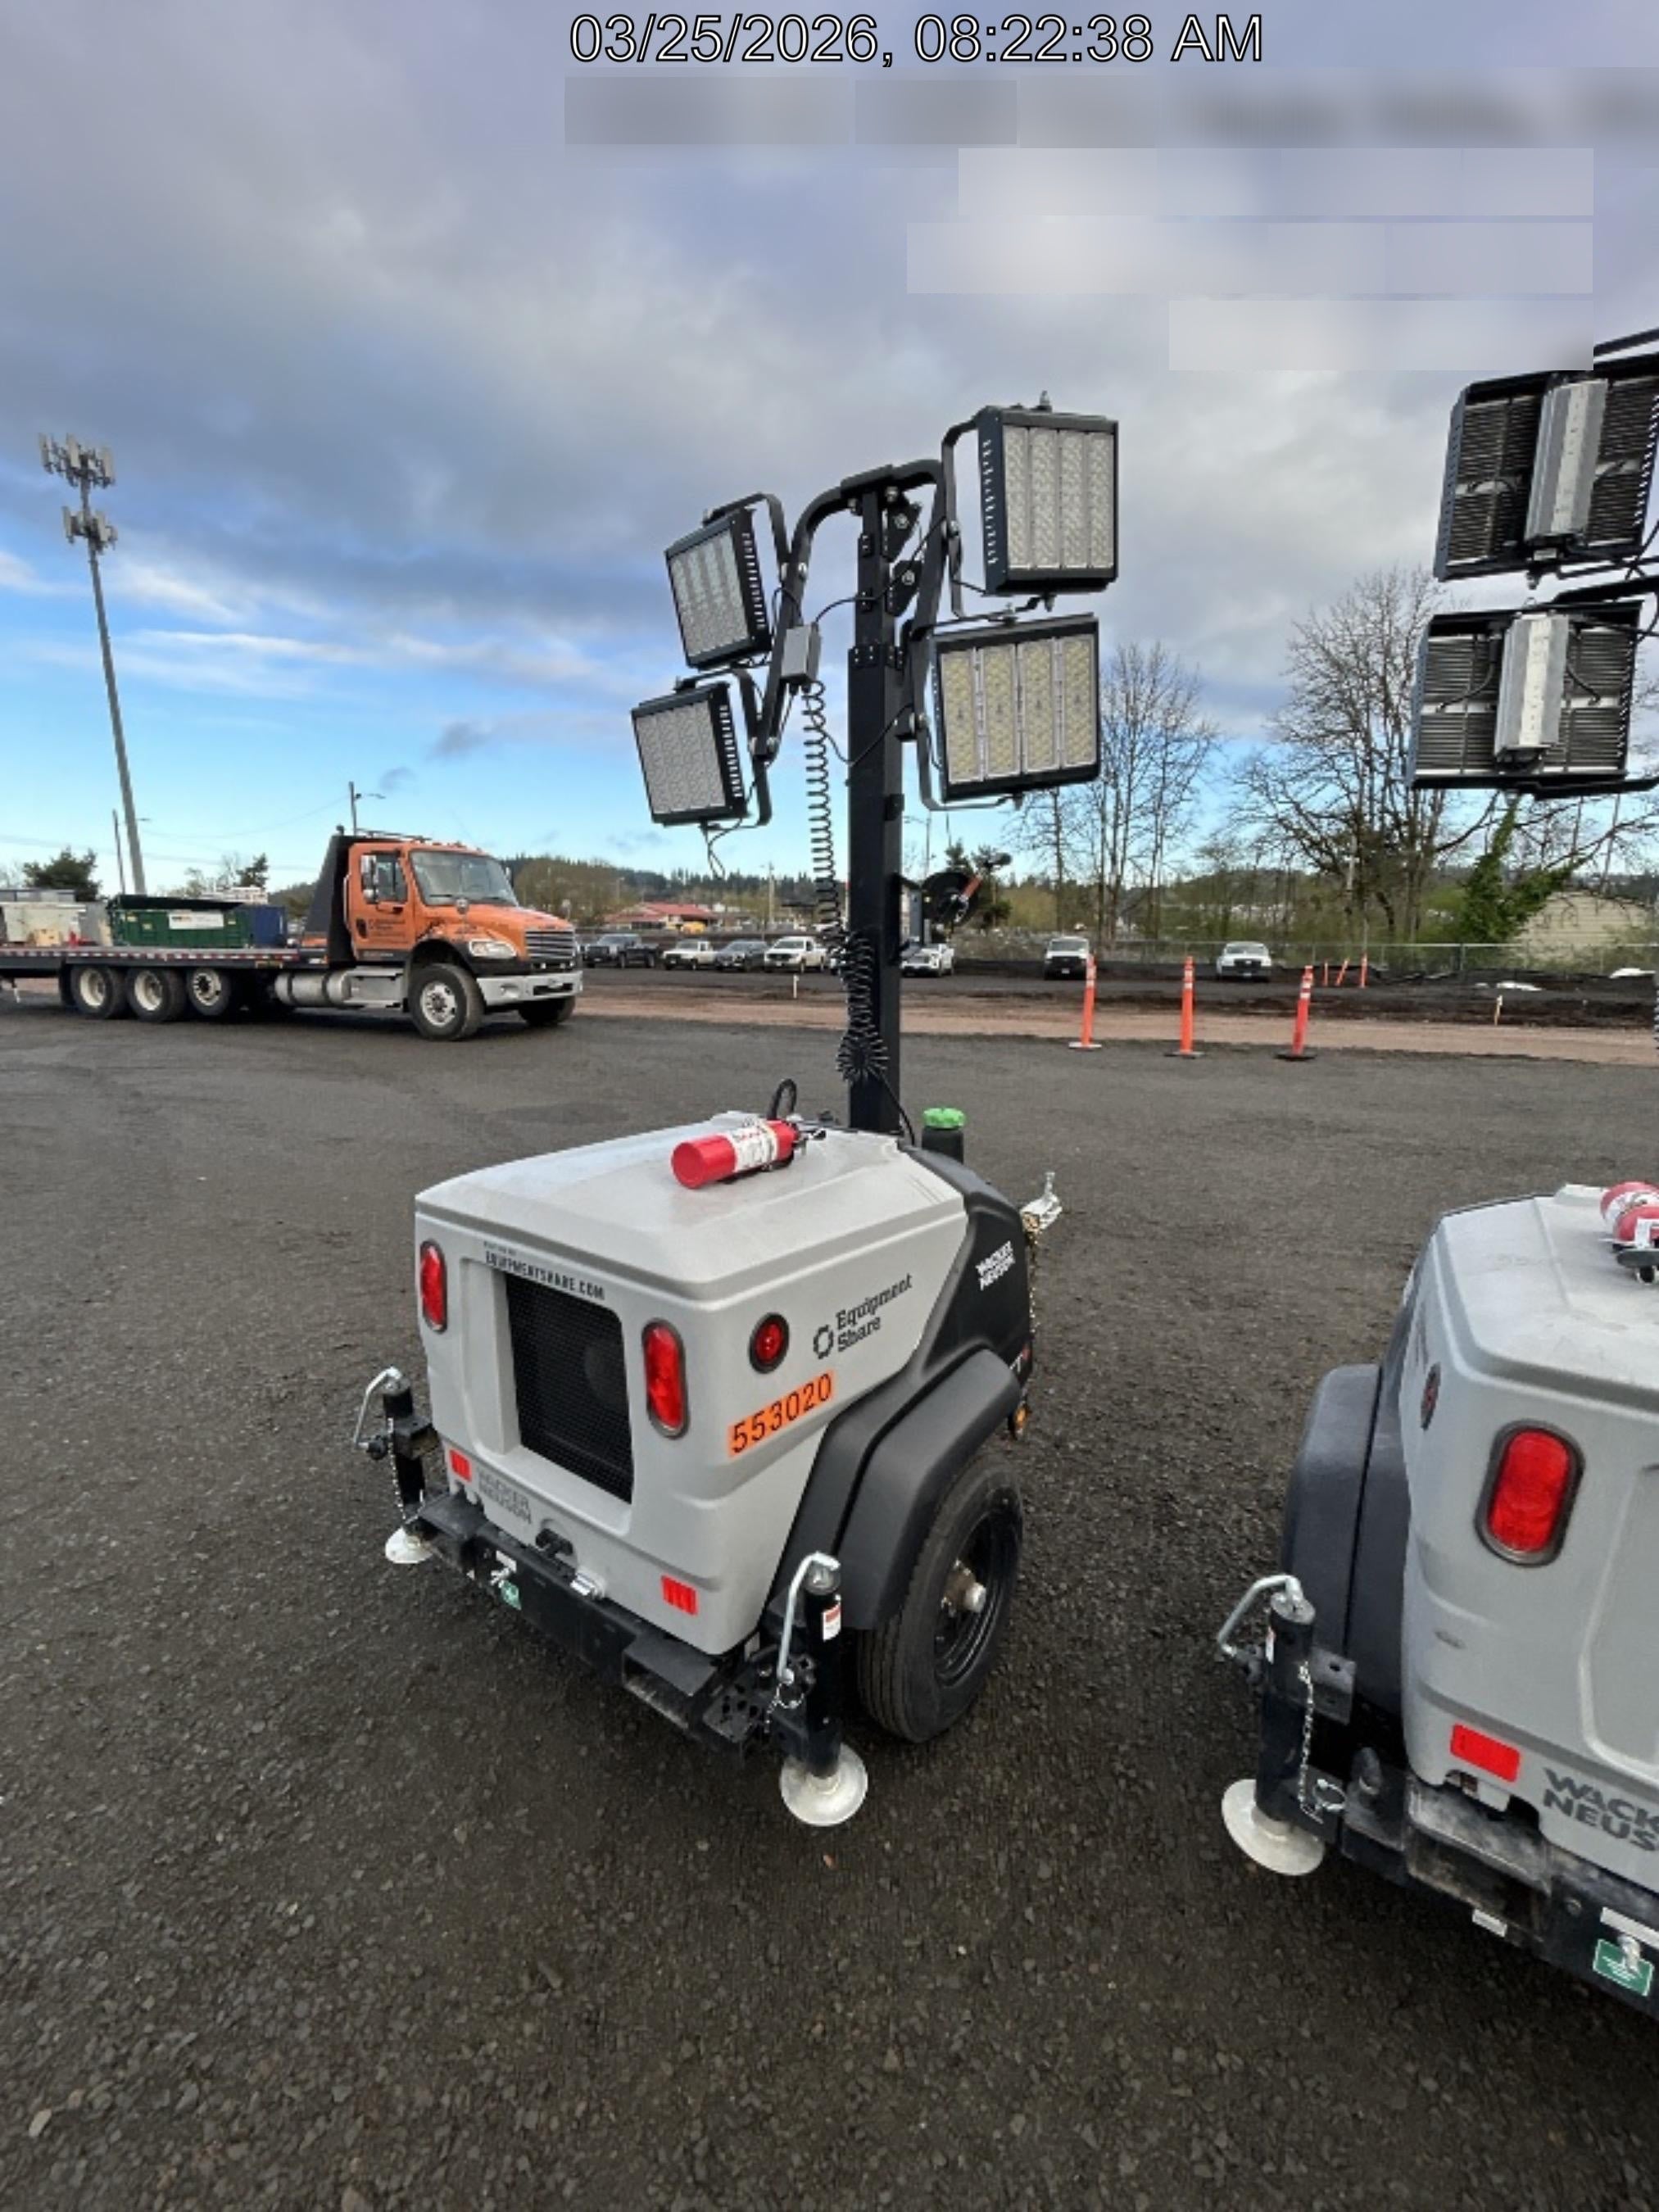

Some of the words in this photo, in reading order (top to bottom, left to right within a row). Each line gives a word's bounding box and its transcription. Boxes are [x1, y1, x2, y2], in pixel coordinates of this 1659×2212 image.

[836, 1272, 913, 1330] Equipment
[837, 1316, 882, 1353] Share
[731, 1372, 832, 1454] 553020
[1543, 1788, 1659, 1852] NEUS
